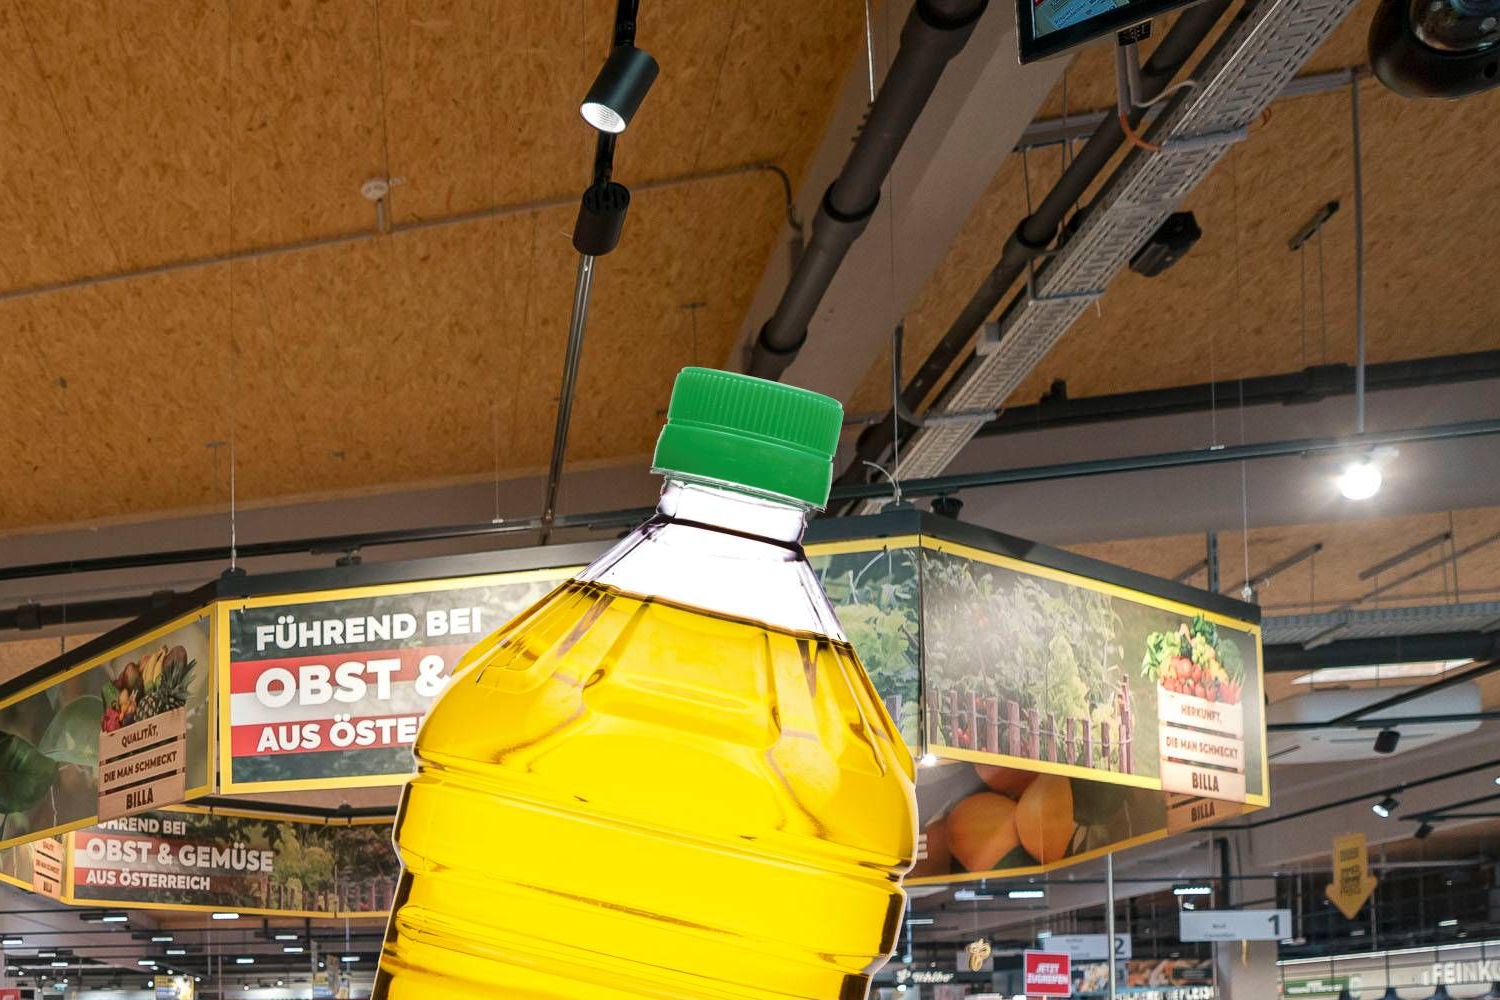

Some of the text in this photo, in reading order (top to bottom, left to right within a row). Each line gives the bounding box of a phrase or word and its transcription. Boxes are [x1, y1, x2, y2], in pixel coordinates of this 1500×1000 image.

[257, 607, 482, 651] FÜHREND BEI
[255, 654, 450, 708] OBST &
[257, 713, 424, 752] AUS ÖSTE
[103, 751, 177, 784] DIE MAN SCHMECKT
[1191, 772, 1220, 792] BILLA
[126, 788, 154, 810] BILLA
[1191, 801, 1215, 822] BILLA
[163, 819, 186, 836] BEI
[85, 838, 274, 872] OBST & GEMÜSE
[85, 868, 211, 891] AUS ÖSTERREICH
[1268, 914, 1280, 936] 1
